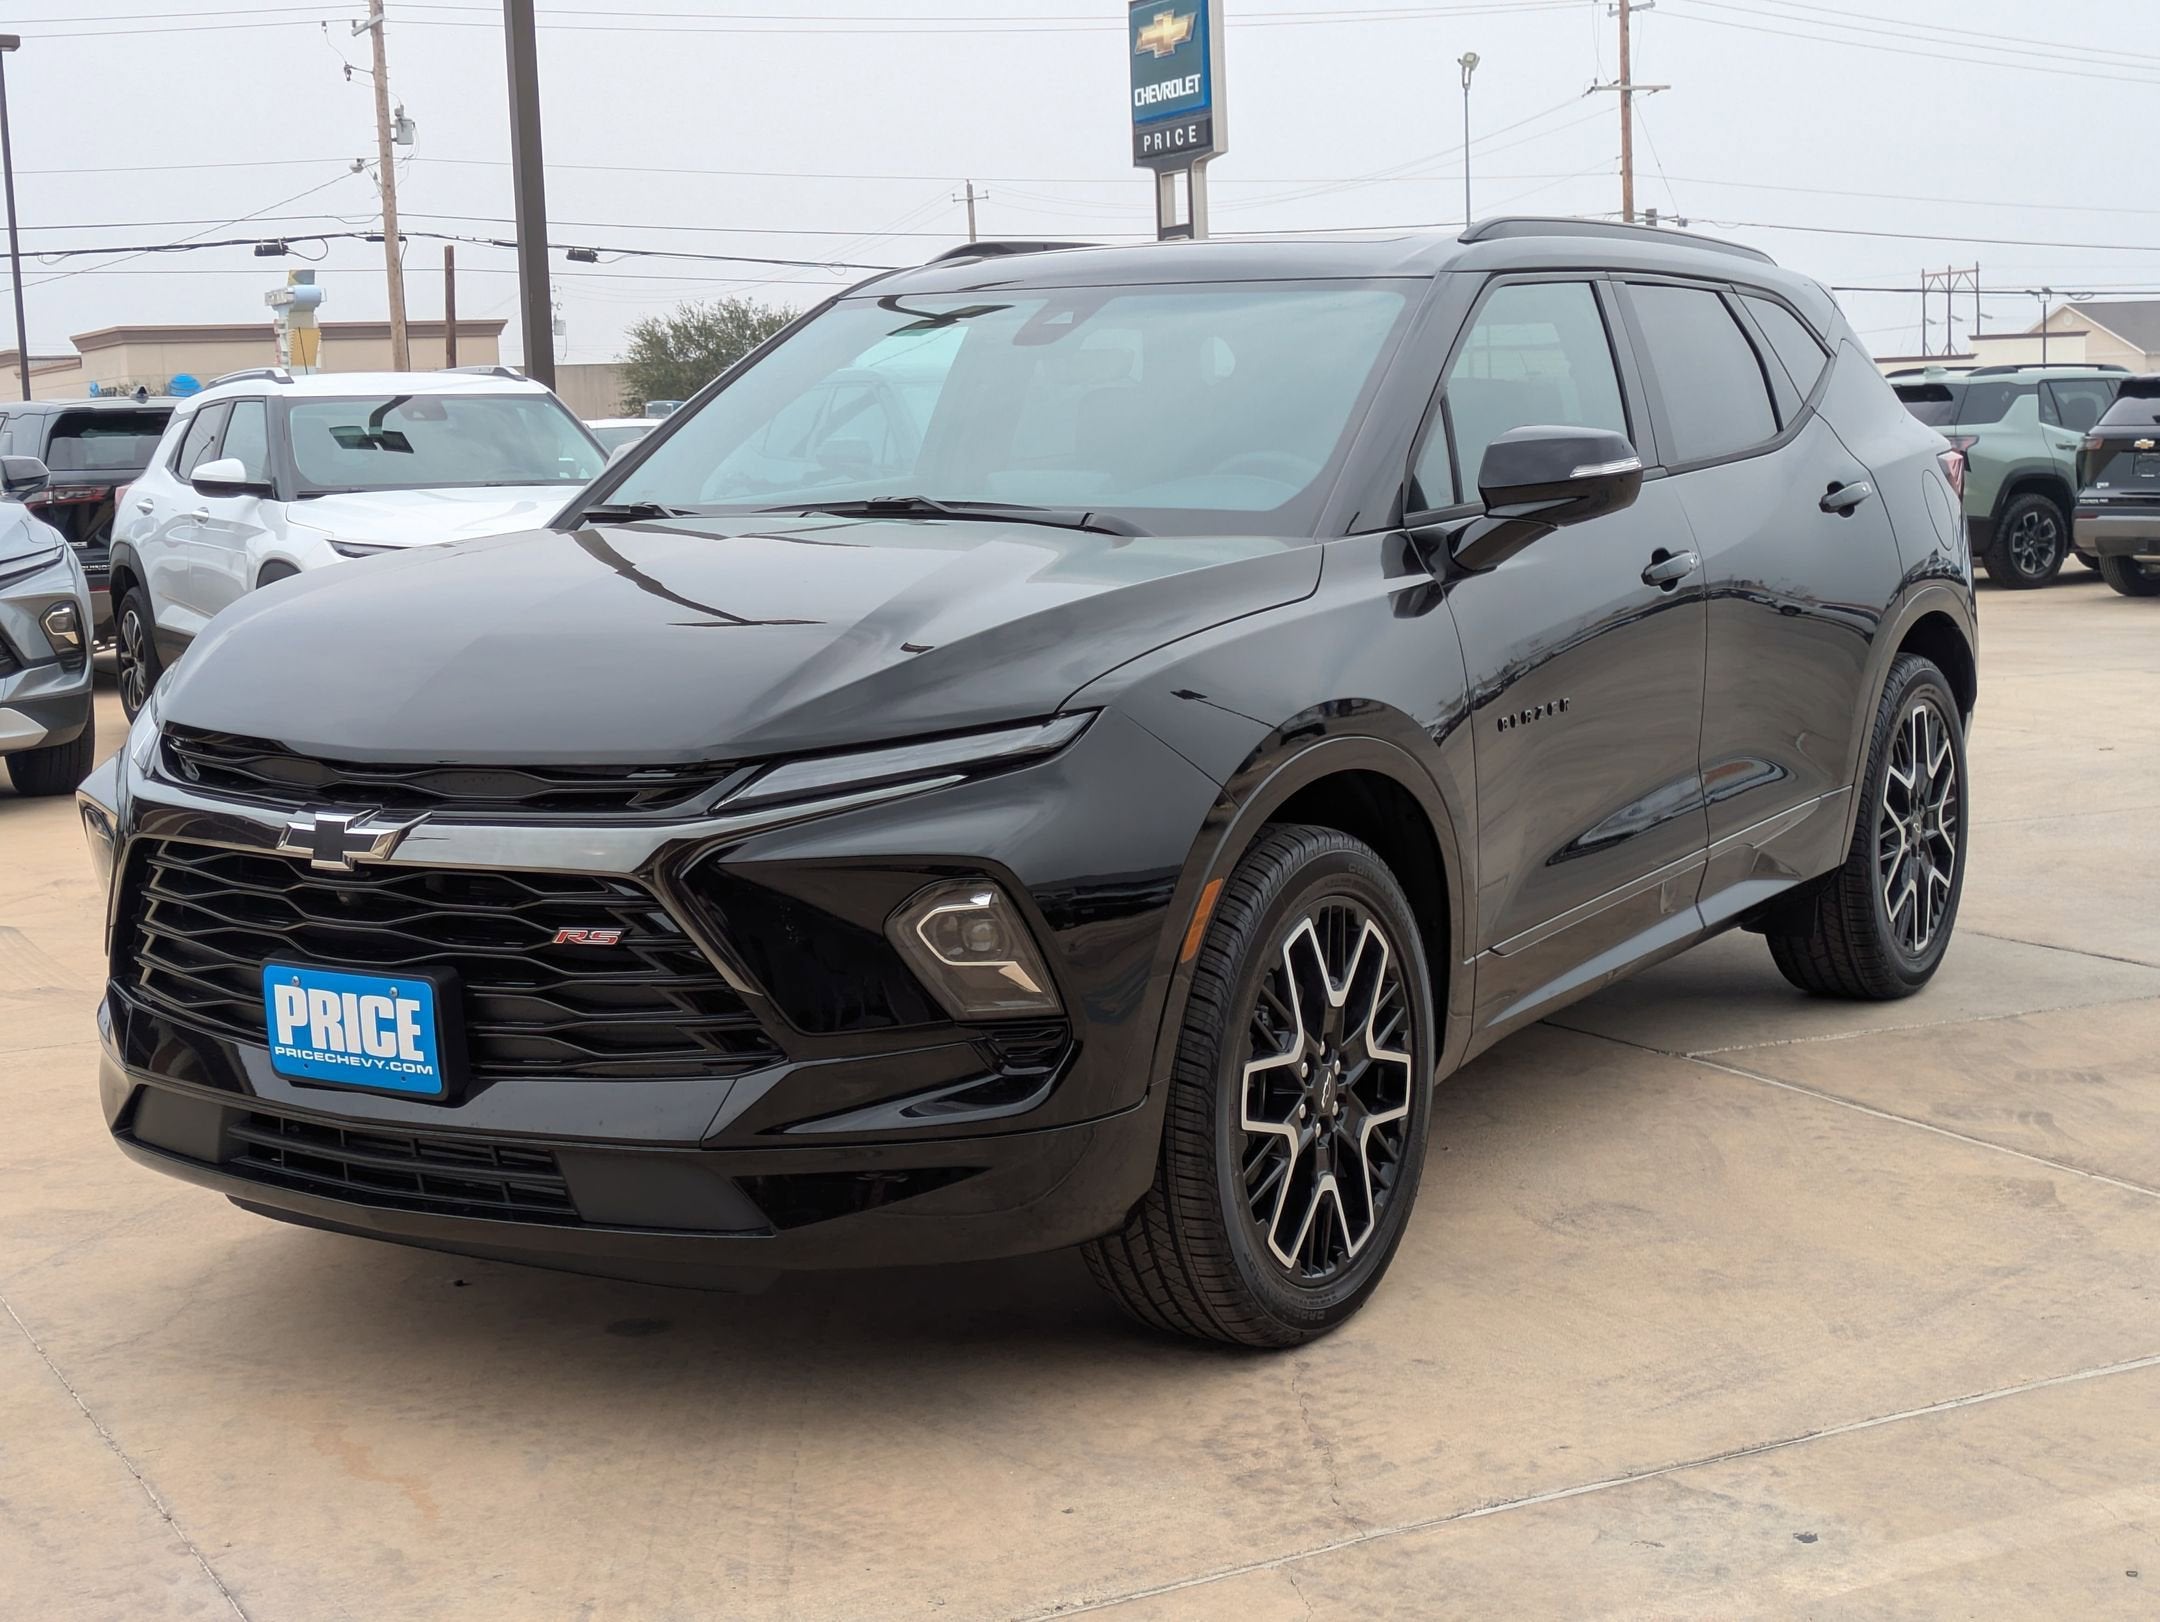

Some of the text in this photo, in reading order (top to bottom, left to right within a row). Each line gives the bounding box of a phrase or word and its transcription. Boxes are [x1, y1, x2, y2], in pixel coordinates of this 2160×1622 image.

[1134, 73, 1201, 107] CHEVROLET
[1143, 125, 1197, 152] PRICE
[1497, 697, 1570, 732] BLAZER
[552, 929, 622, 946] RS
[274, 984, 424, 1062] PRICE
[274, 1046, 433, 1075] PRICECHEVY.COM
